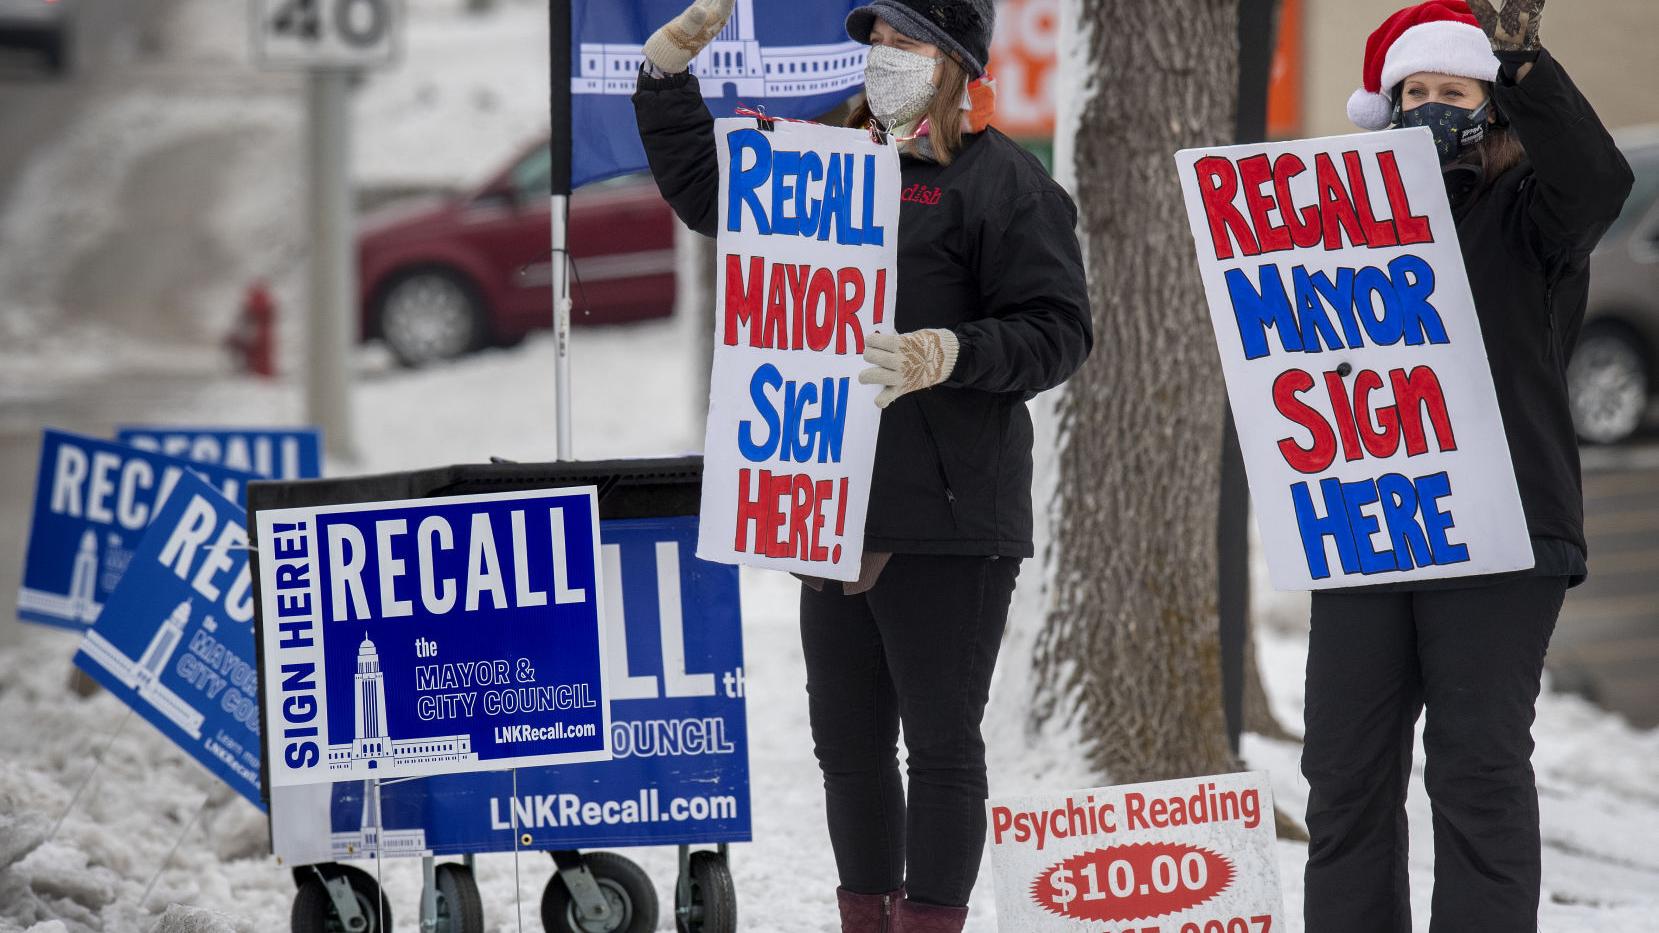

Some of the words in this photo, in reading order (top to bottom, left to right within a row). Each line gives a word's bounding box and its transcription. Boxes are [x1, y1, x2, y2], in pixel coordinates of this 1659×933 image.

[271, 0, 391, 51] 40
[727, 128, 884, 246] RECALL
[1194, 150, 1434, 260] RECALL
[1224, 254, 1450, 360] MAYOR
[737, 363, 850, 464] SIGN
[734, 468, 849, 565] HERE!
[1290, 471, 1471, 580] HERE
[272, 521, 314, 649] HERE!
[327, 506, 586, 622] RECALL
[415, 636, 438, 658] the
[415, 659, 510, 691] MAYOR
[515, 657, 536, 683] &
[281, 663, 320, 769] SIGN
[417, 692, 477, 721] CITY
[483, 683, 597, 716] COUNCIL
[494, 722, 596, 744] LNKRecall.com
[610, 717, 734, 758] OUNCIL
[490, 789, 737, 830] LNKRecall.com
[992, 795, 1117, 850] Psychic
[1124, 782, 1262, 831] Reading
[1049, 851, 1208, 912] $10.00
